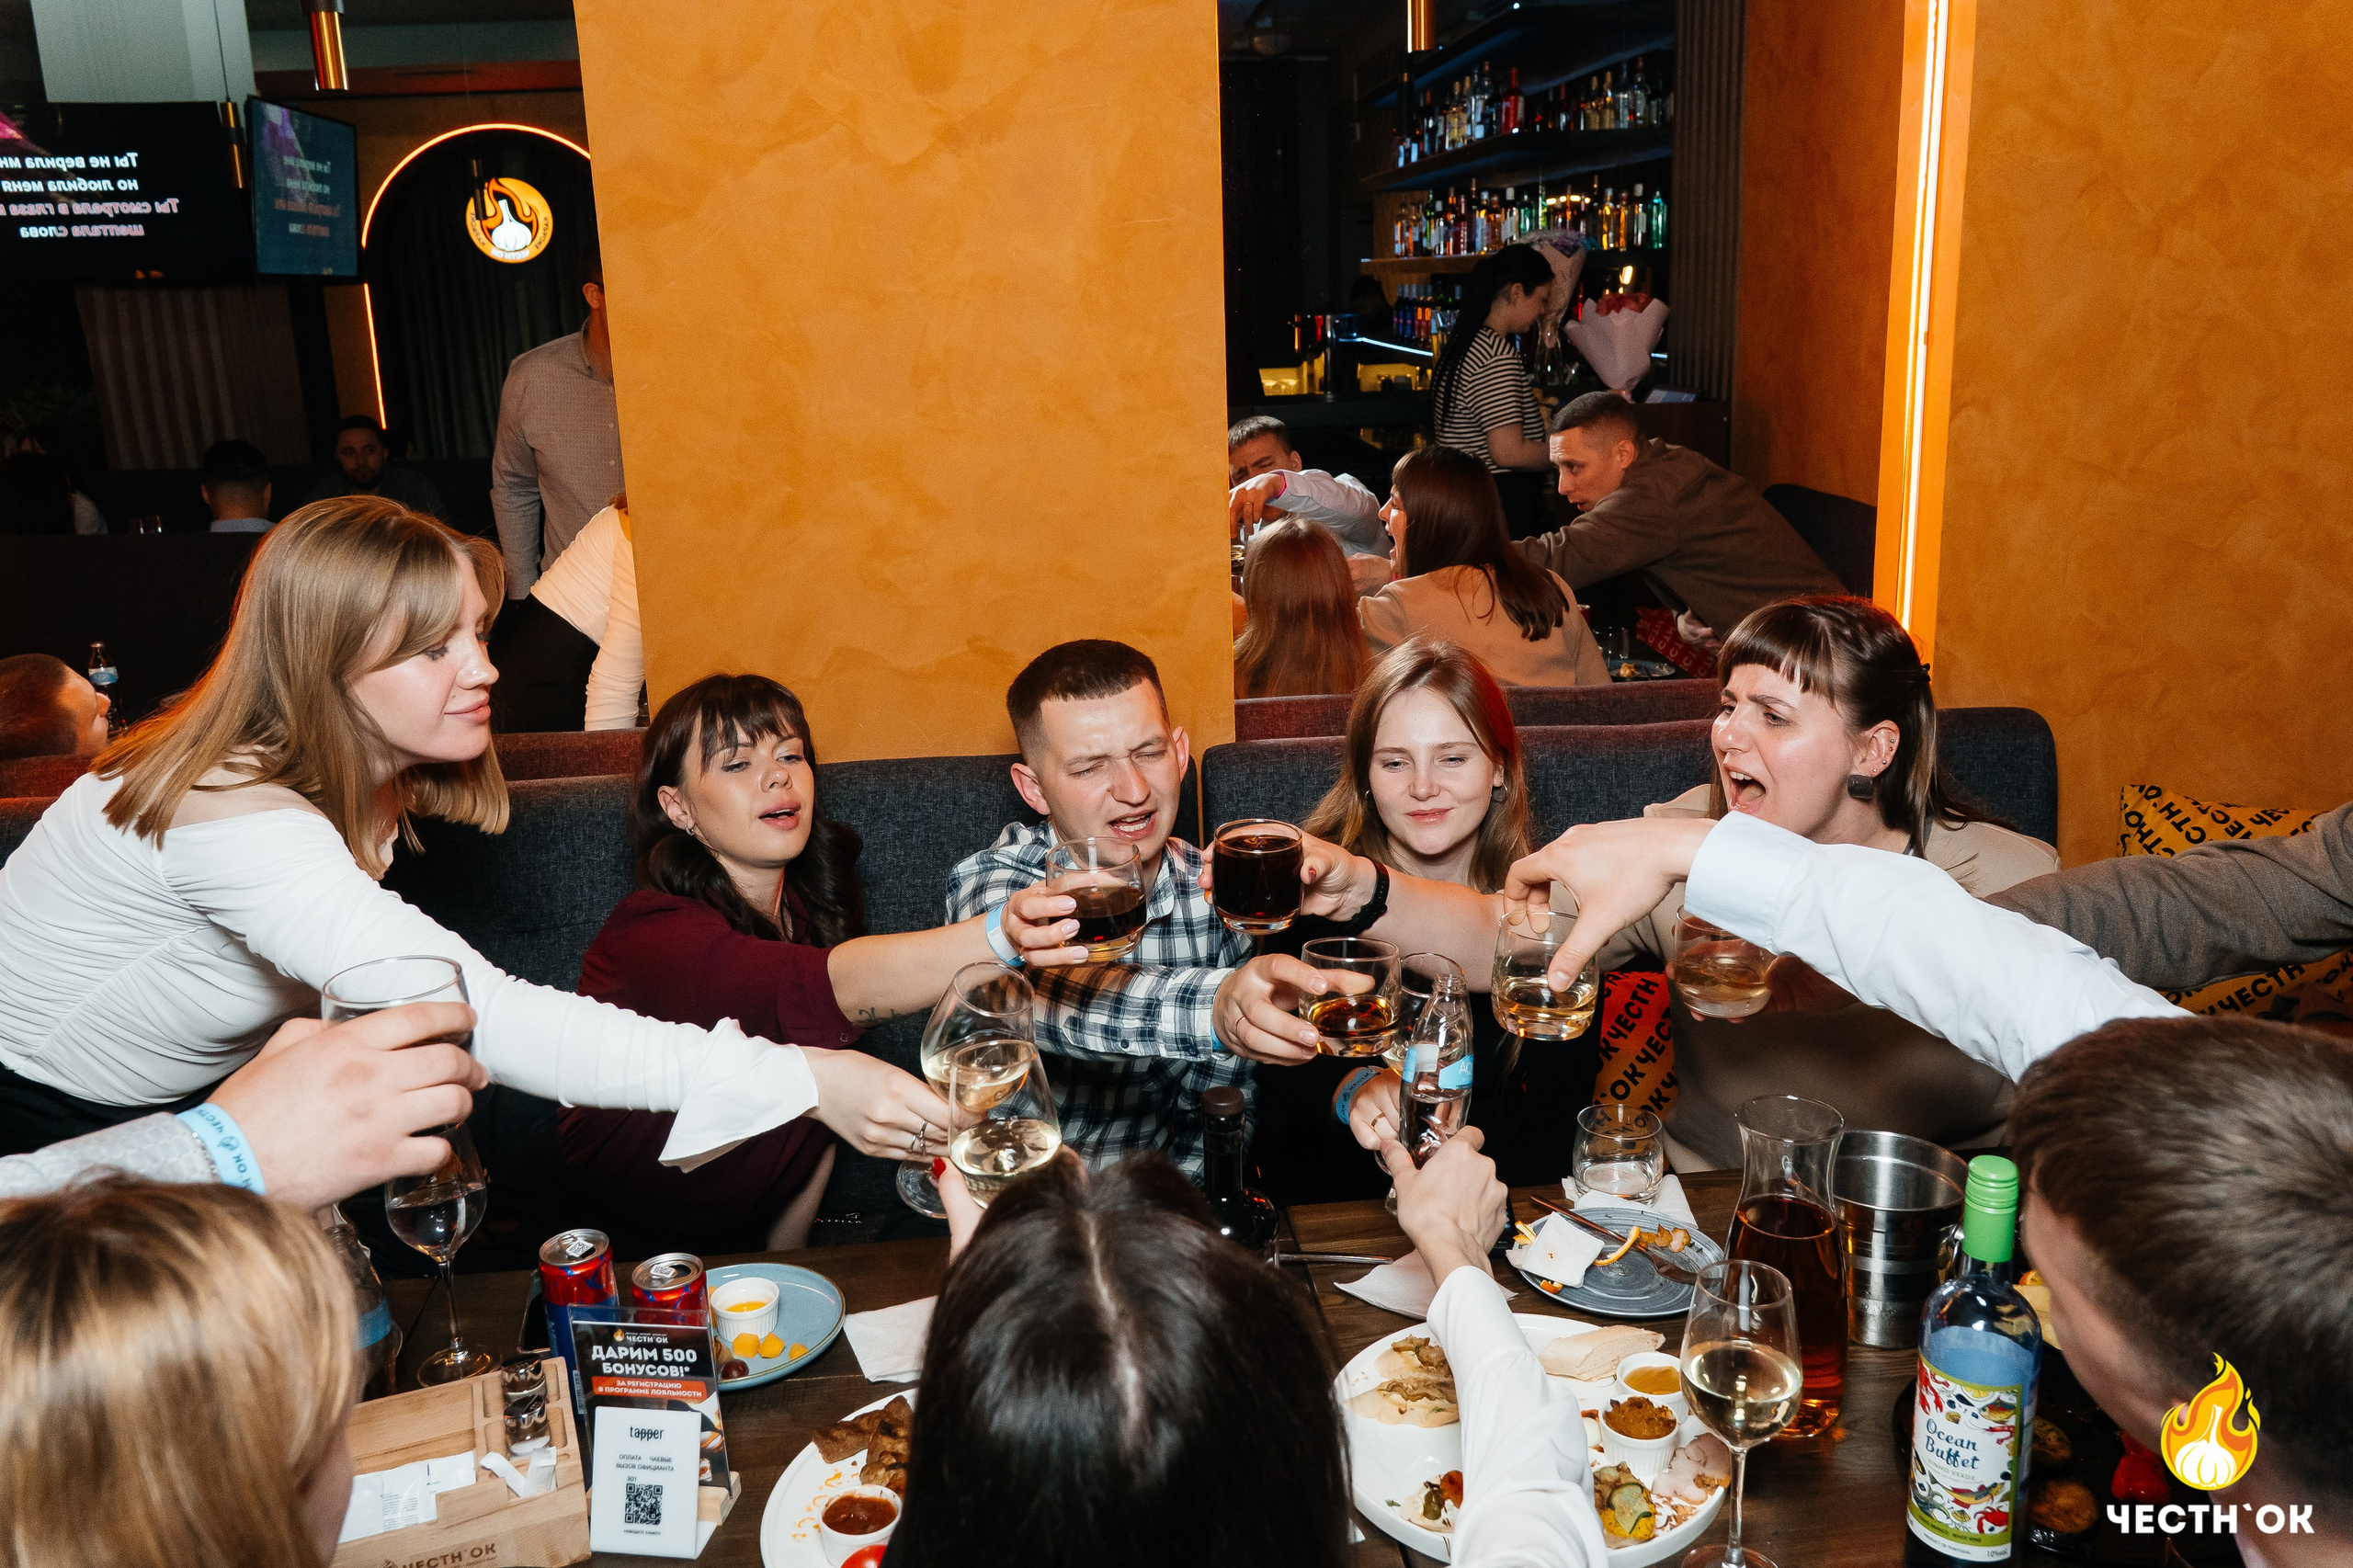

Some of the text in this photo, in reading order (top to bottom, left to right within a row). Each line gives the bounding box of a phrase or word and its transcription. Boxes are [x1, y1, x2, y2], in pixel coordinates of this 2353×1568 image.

[591, 1345, 698, 1363] ДАРИМ 500
[604, 1386, 650, 1395] ПРОГРАММЕ
[651, 1389, 702, 1397] ЛОЯЛЬНОСТИ
[627, 1381, 682, 1390] РЕГИСТРАЦИЮ
[630, 1426, 665, 1441] tapper
[1926, 1418, 1978, 1451] Ocean
[619, 1453, 642, 1461] ОПЛАТА
[1926, 1435, 1980, 1470] Buffet
[637, 1463, 675, 1471] ОФИЦИАНТА
